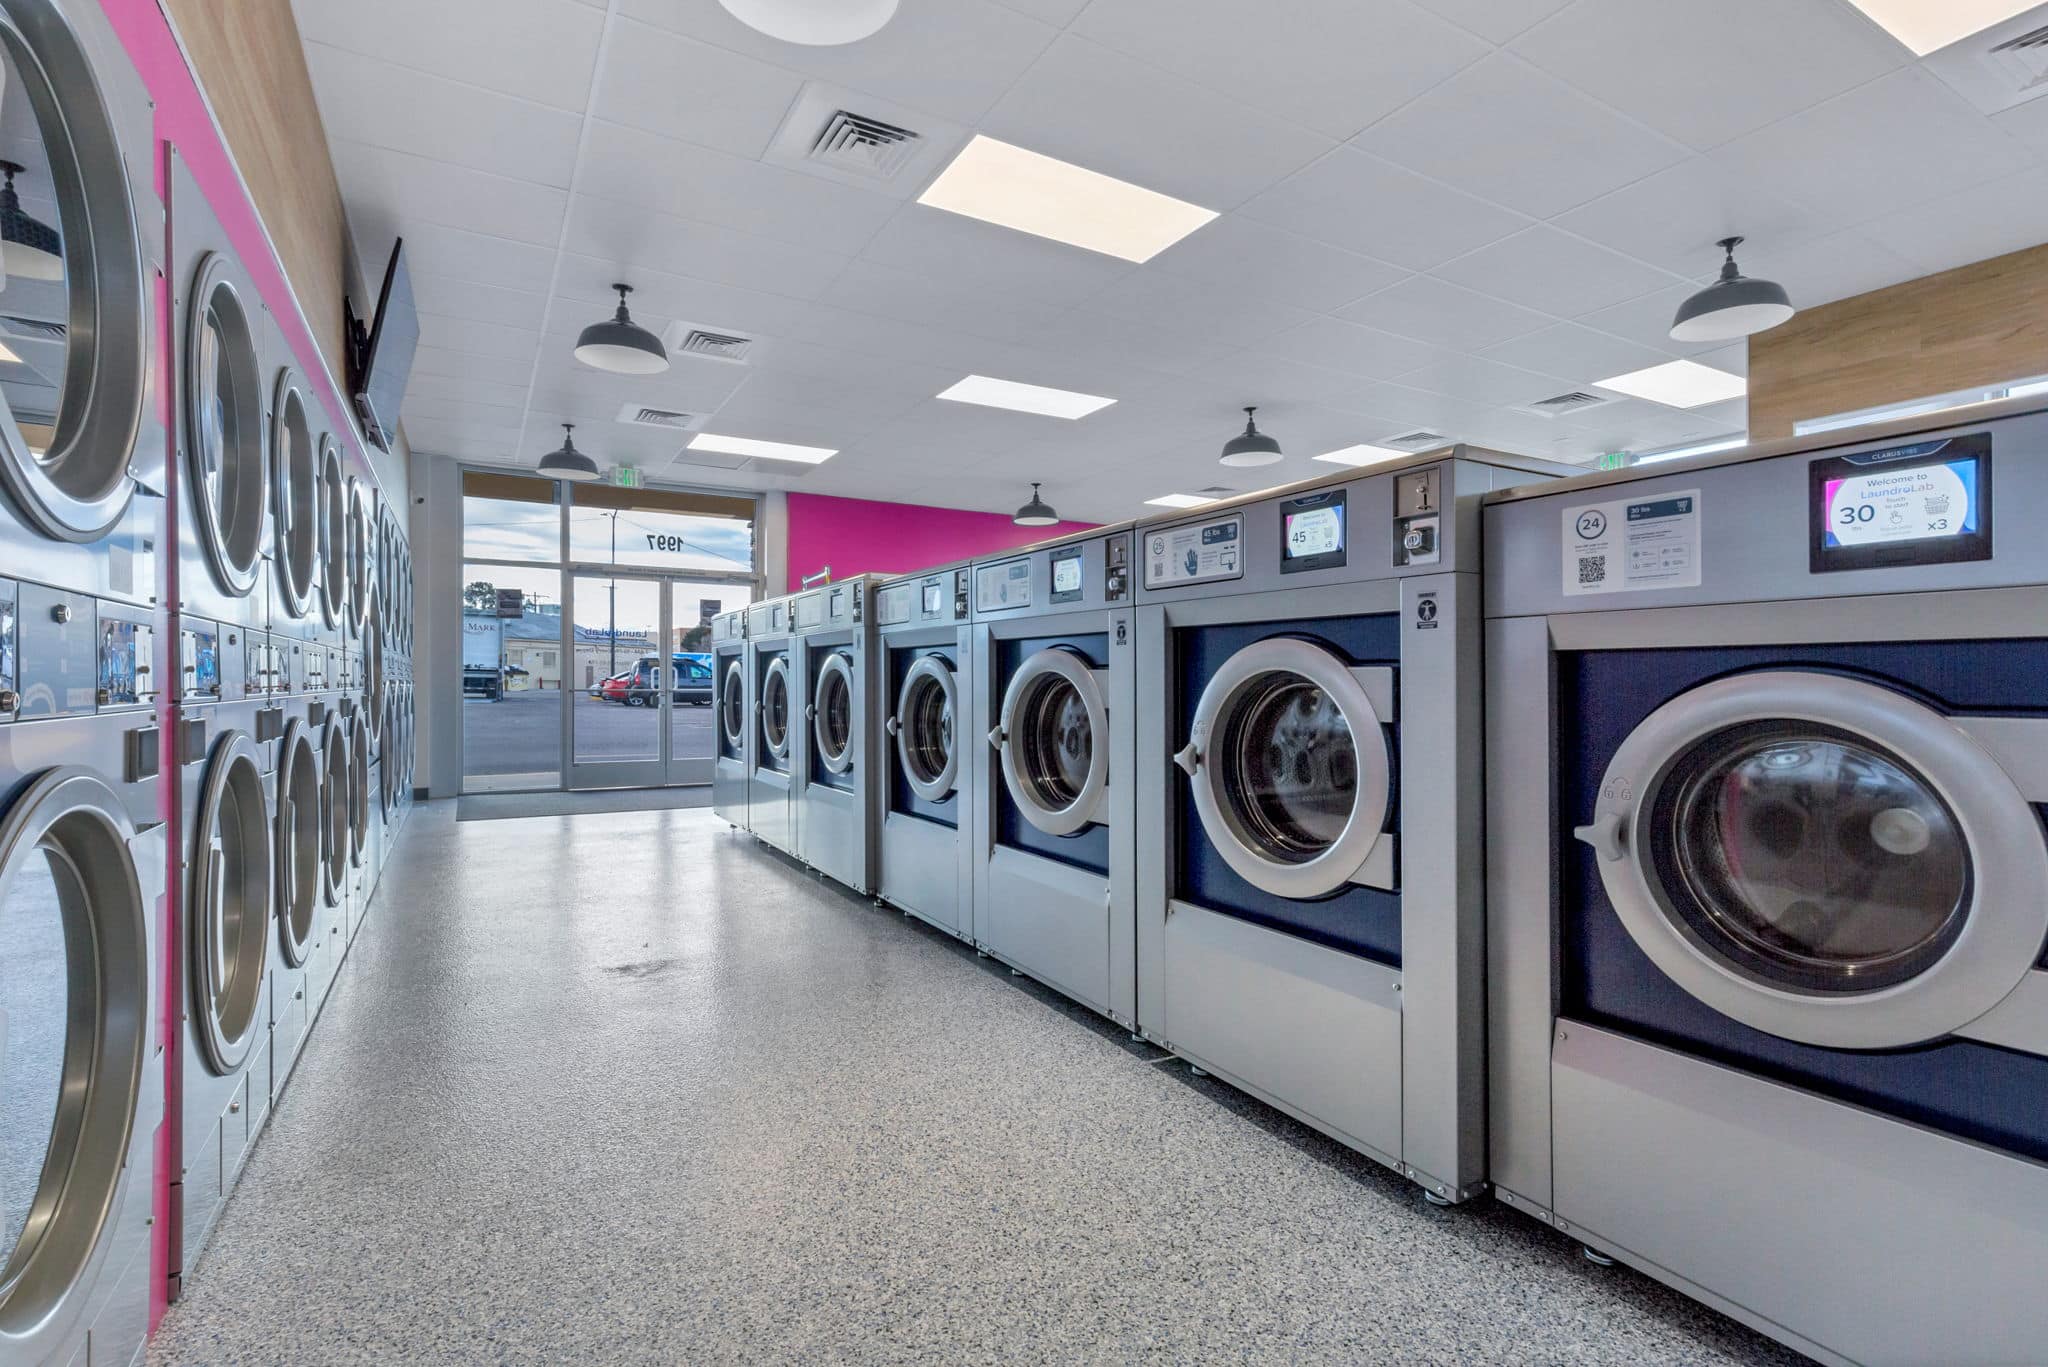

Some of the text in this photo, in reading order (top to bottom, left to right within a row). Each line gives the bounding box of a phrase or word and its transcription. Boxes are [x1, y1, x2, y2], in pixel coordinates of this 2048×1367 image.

[1867, 473, 1928, 487] Welcome to
[1860, 483, 1935, 500] LaundroLab
[1839, 504, 1875, 525] 30
[1582, 517, 1601, 531] 24
[1292, 531, 1306, 543] 45
